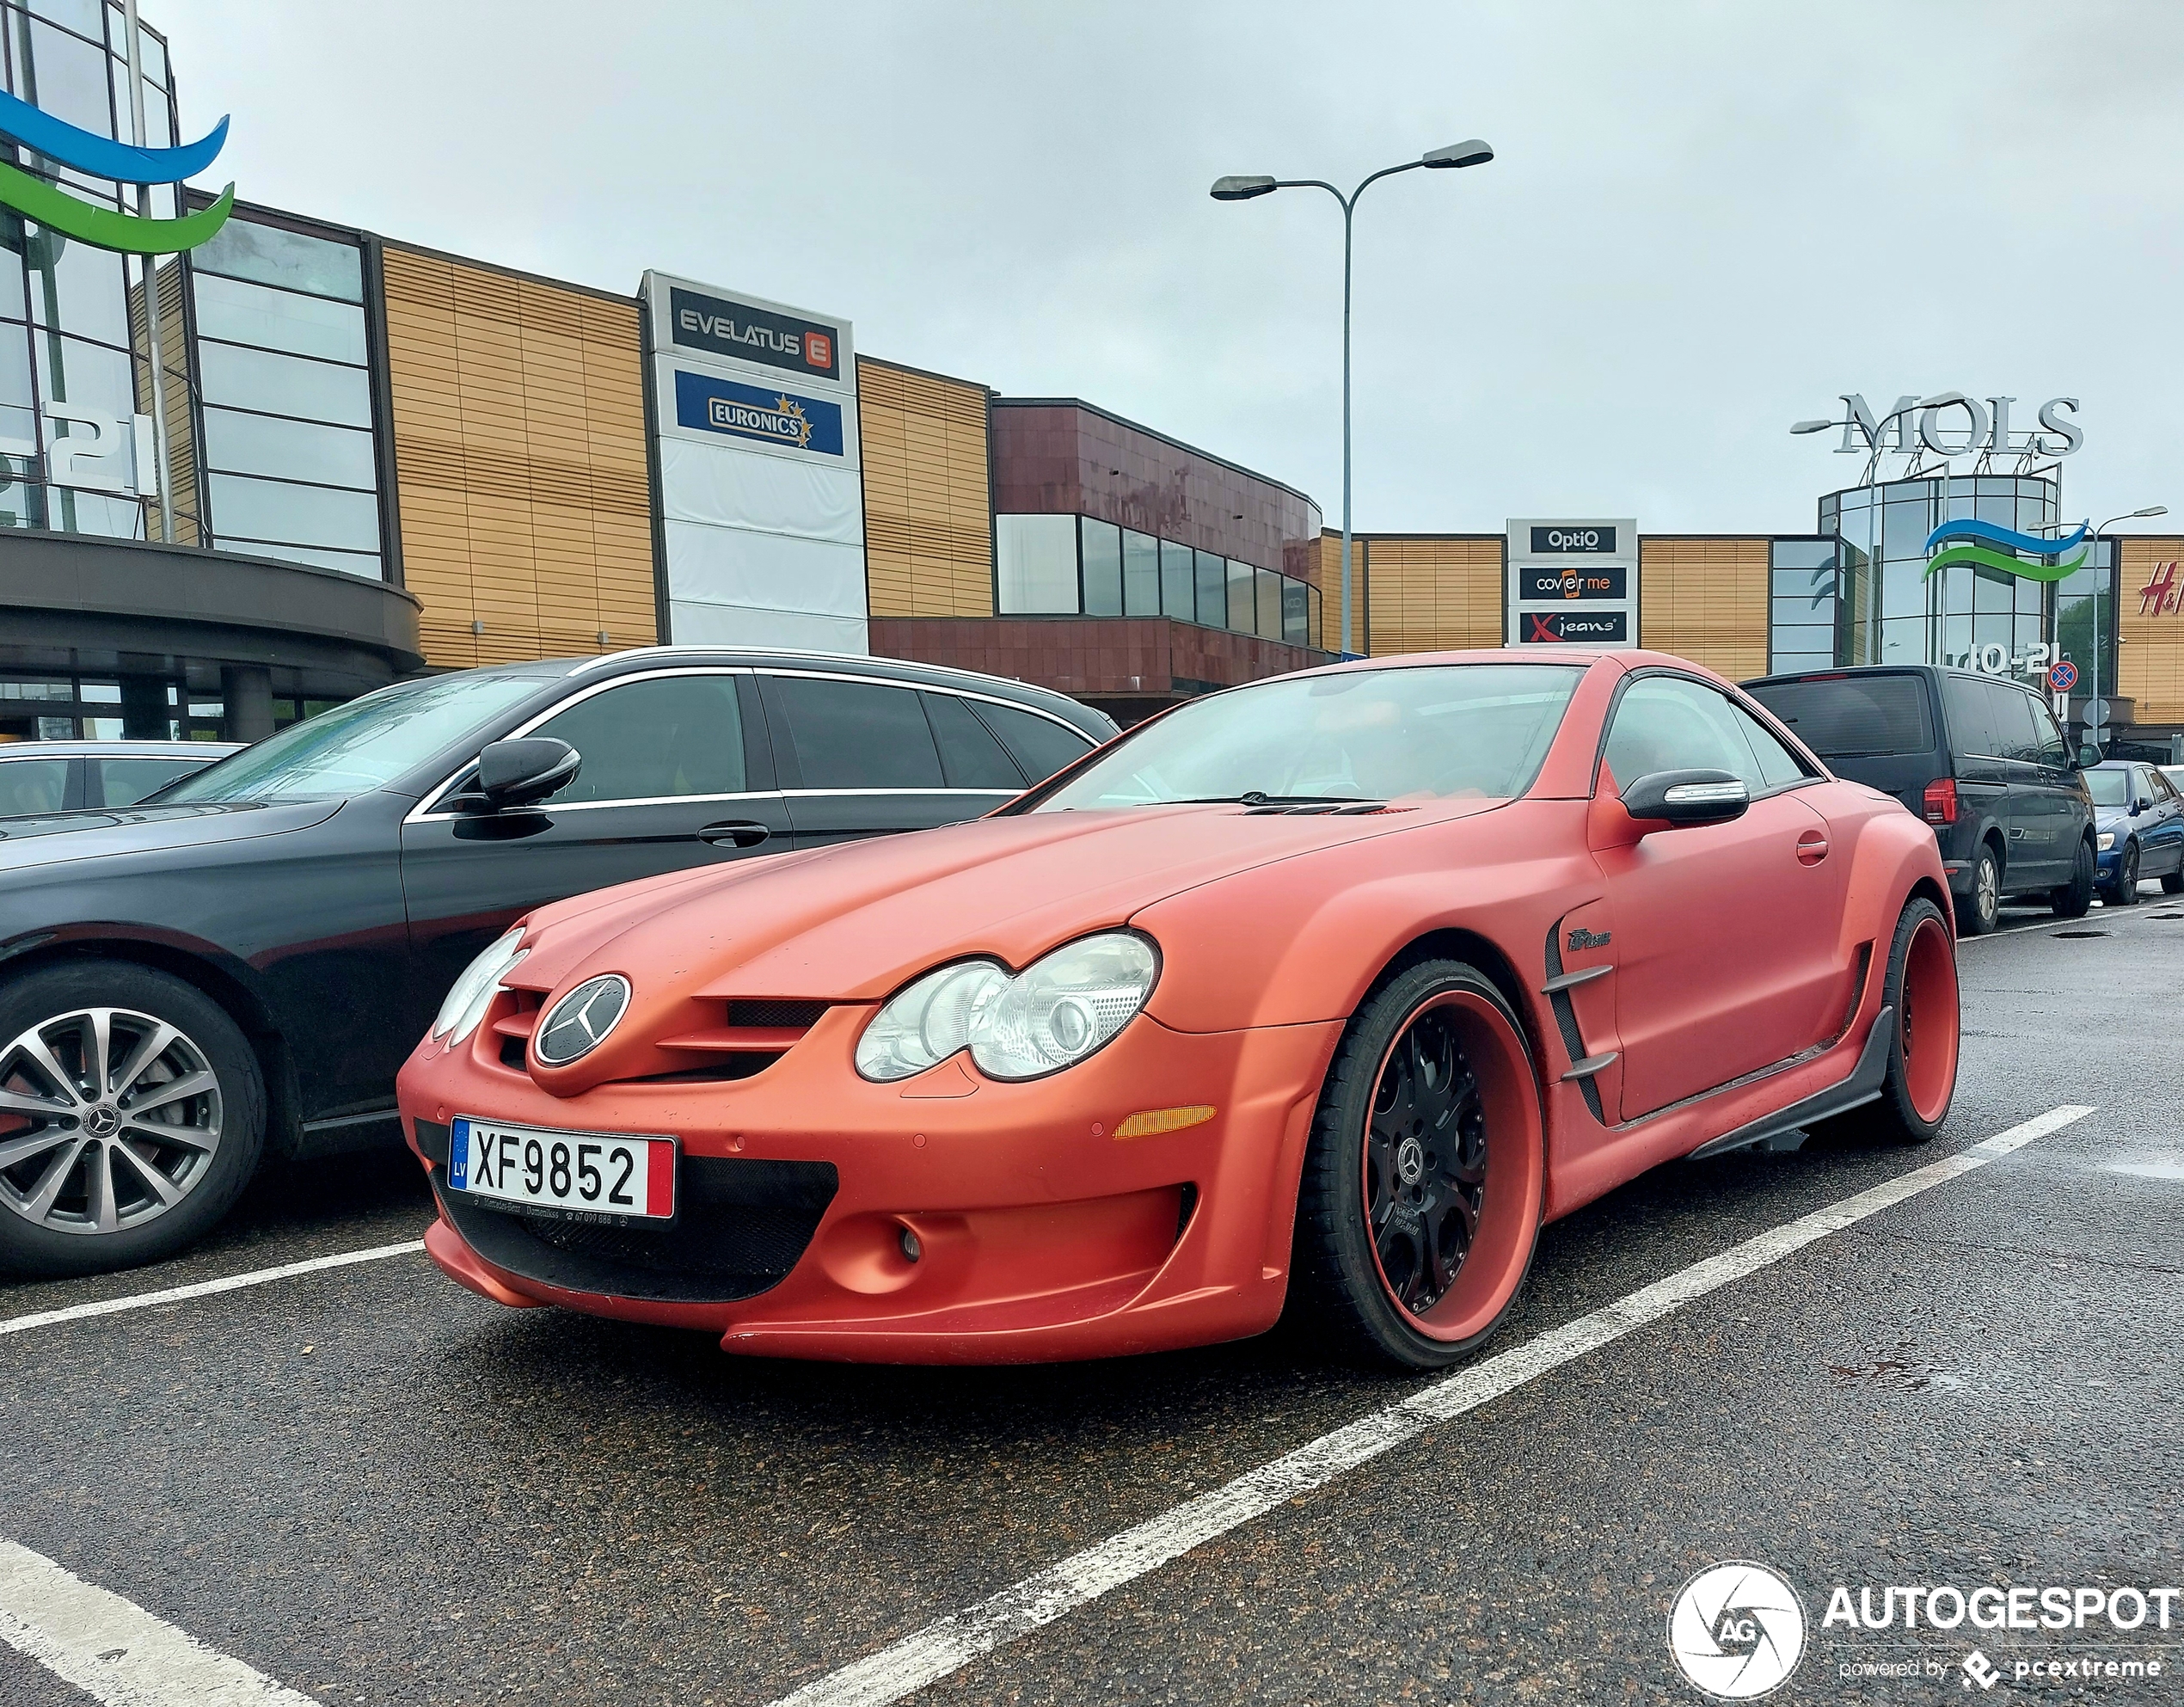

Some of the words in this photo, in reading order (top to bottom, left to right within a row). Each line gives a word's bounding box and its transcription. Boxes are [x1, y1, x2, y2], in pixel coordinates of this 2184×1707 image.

[680, 308, 800, 356] EVELATUS
[715, 404, 799, 437] EURONICS
[1833, 393, 2084, 457] MOLS
[1548, 530, 1599, 551] OptiO
[1537, 576, 1585, 591] cover
[1587, 577, 1610, 590] me
[2138, 561, 2184, 617] H&
[1969, 642, 2060, 674] 10-21
[454, 1162, 467, 1177] LV
[475, 1130, 635, 1206] XF9852
[574, 1212, 583, 1221] 67
[584, 1213, 597, 1224] 099
